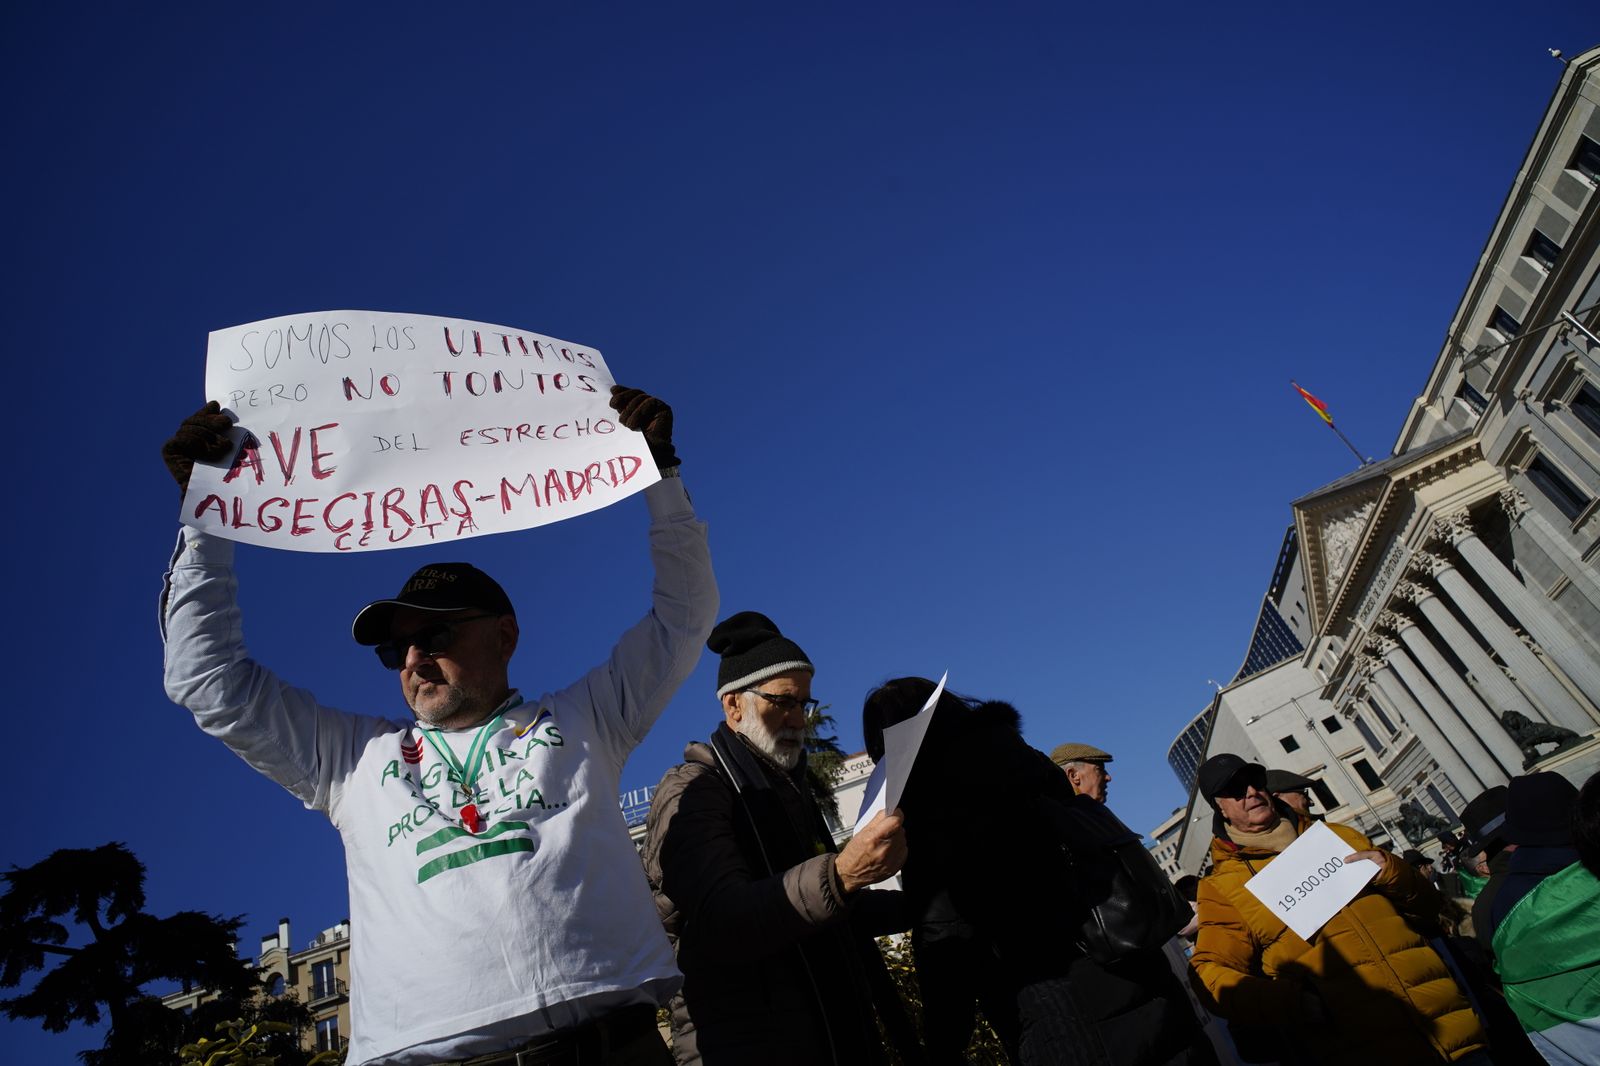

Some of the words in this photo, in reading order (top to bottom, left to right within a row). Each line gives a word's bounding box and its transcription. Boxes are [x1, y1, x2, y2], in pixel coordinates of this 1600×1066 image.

[229, 323, 351, 371] SOMOS
[372, 324, 416, 352] LOS
[443, 326, 596, 369] ULTIMOS
[229, 383, 308, 408] PERO
[342, 367, 401, 401] NO
[433, 368, 598, 400] TONTOS
[222, 422, 340, 487] AVE
[373, 432, 431, 453] DEL
[459, 417, 616, 447] ESTRECHO
[334, 516, 480, 551] CEUTA
[498, 768, 535, 798] LA
[850, 759, 874, 772] COLE
[1278, 856, 1344, 912] 19.300.000
